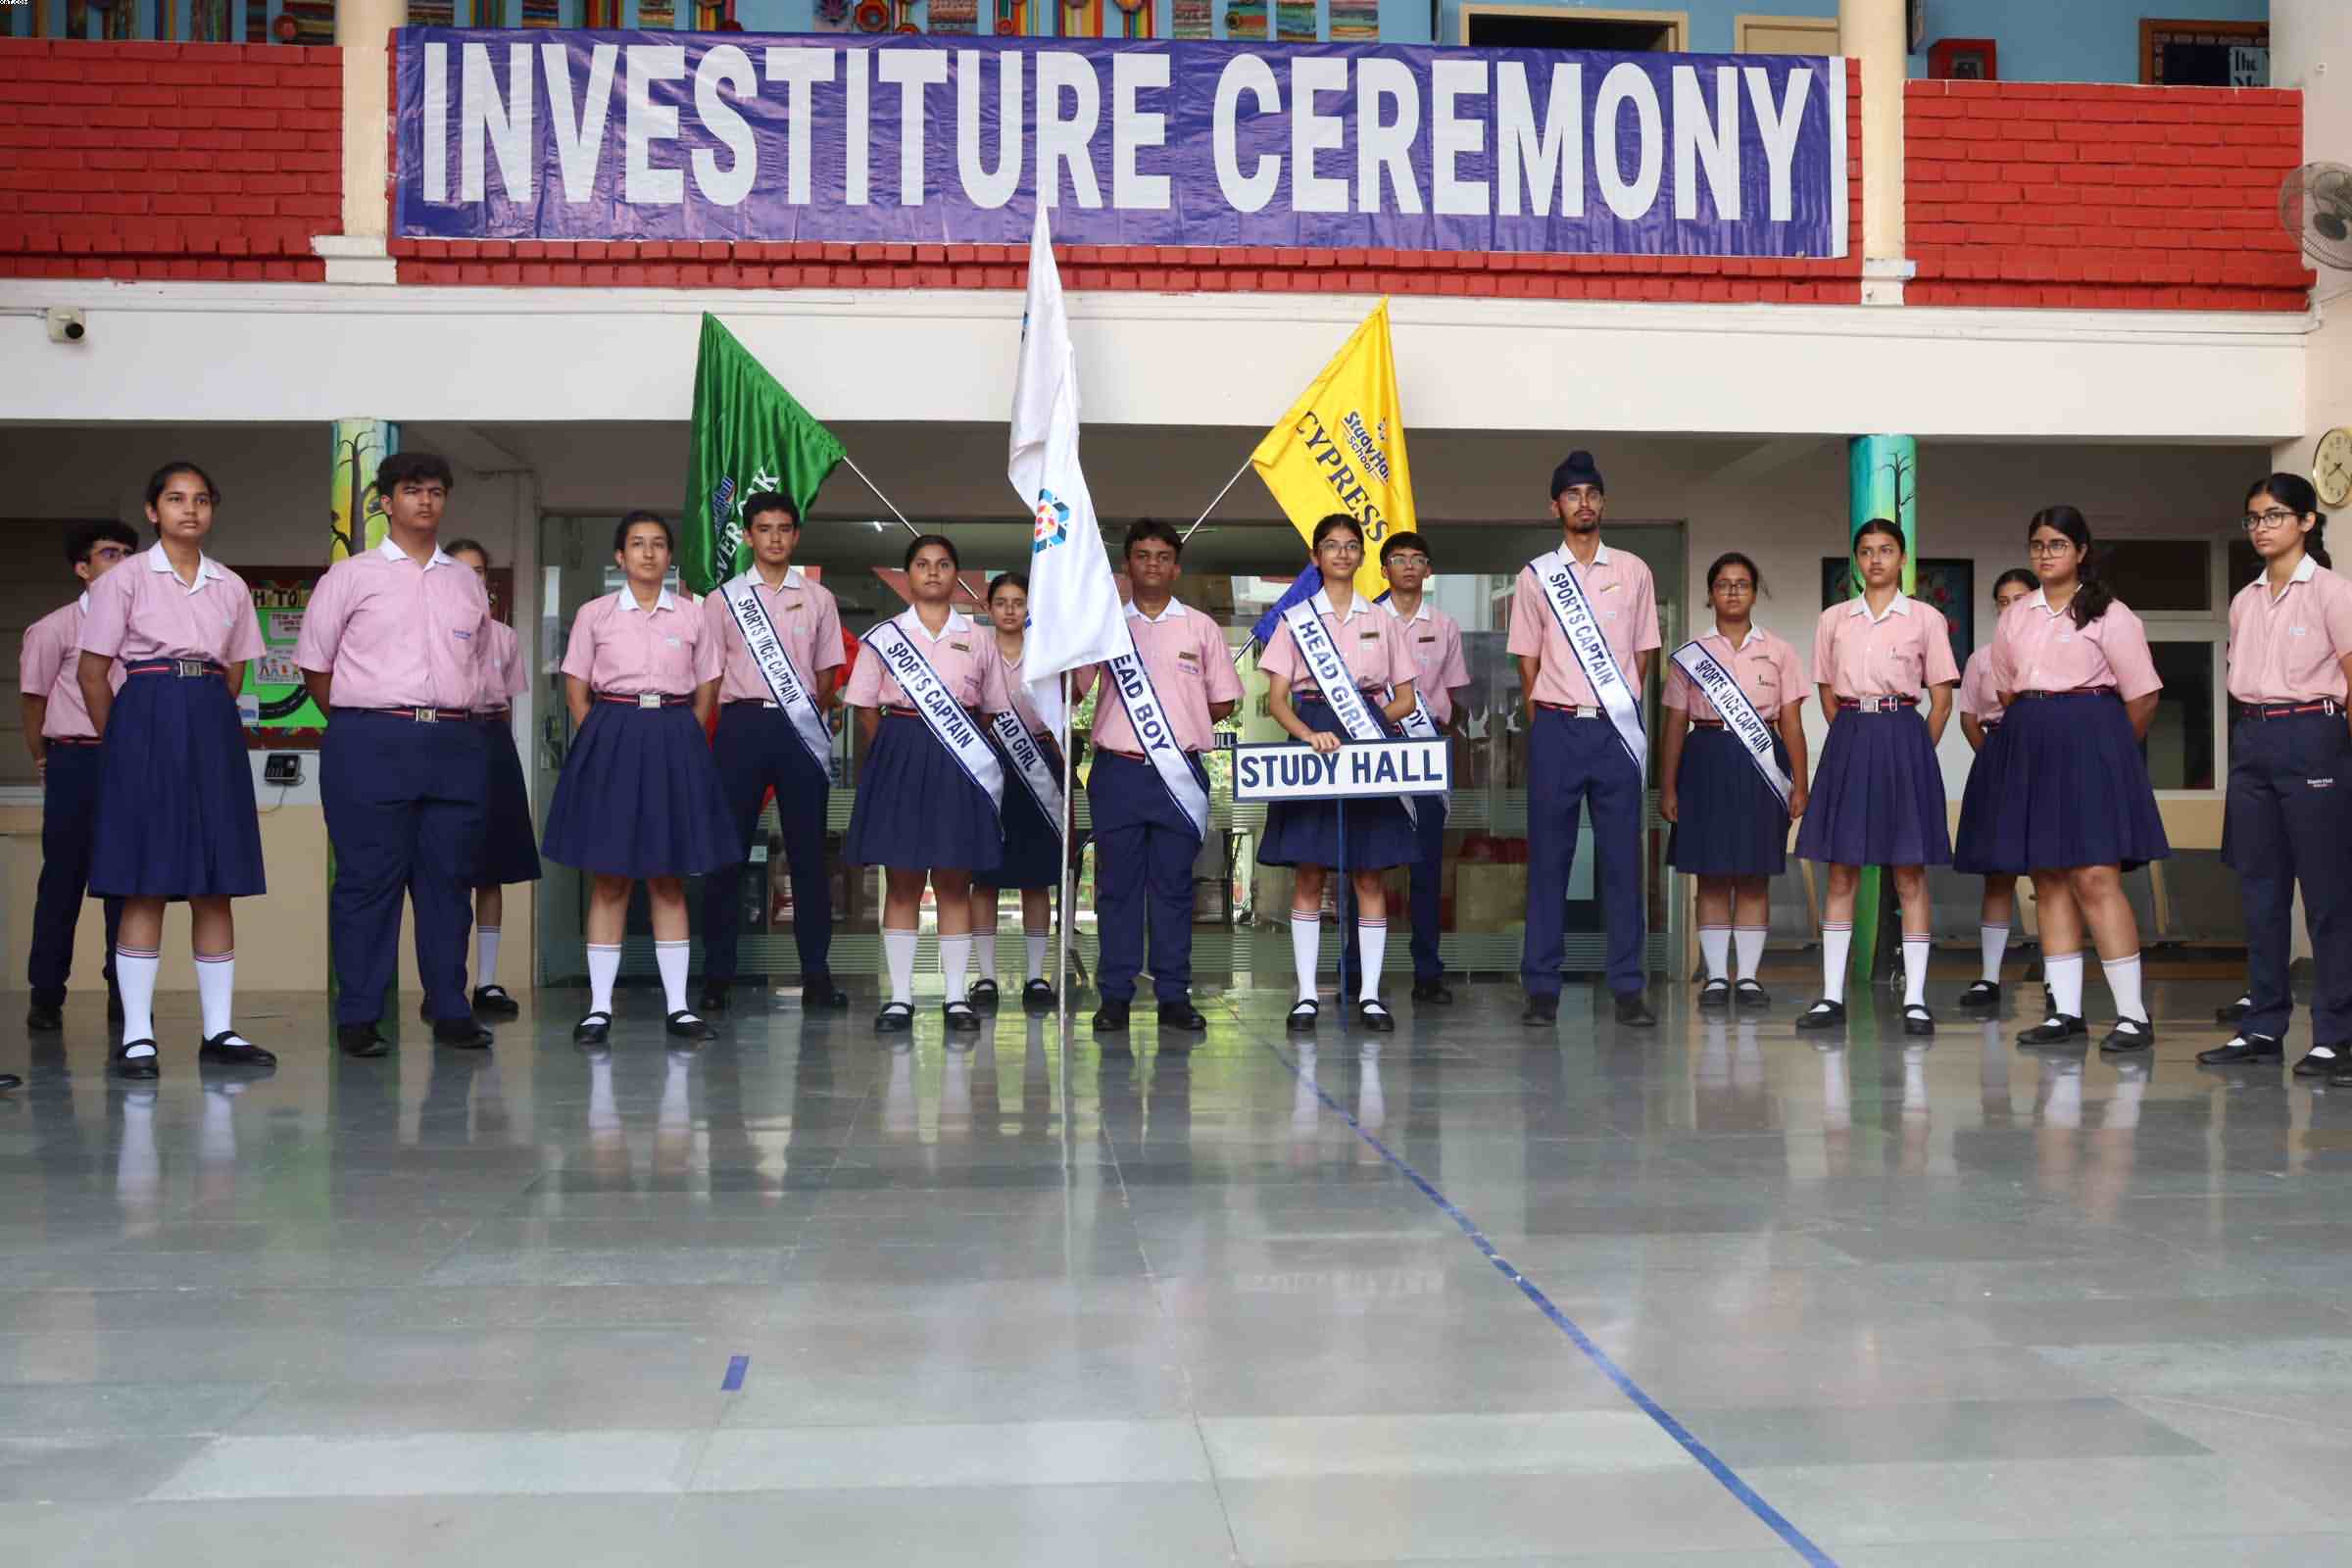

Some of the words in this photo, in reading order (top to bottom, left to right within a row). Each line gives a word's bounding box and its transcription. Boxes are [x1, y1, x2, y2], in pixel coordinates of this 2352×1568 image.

[423, 42, 1172, 209] INVESTITURE
[1212, 53, 1812, 222] CEREMONY
[1296, 411, 1390, 541] CYPRESS
[1344, 411, 1376, 454] Study
[1369, 451, 1389, 483] Hal
[738, 598, 767, 637] SPORTS
[758, 633, 777, 663] VICE
[768, 661, 801, 705] CAPTAIN
[1298, 620, 1339, 680] HEAD
[1330, 687, 1368, 738] GIRL
[1549, 572, 1586, 625] SPORTS
[1575, 624, 1615, 687] CAPTAIN
[887, 642, 932, 691] SPORTS
[923, 689, 975, 749] CAPTAIN
[995, 710, 1020, 738] EAD
[1012, 739, 1038, 772] GIRL
[1113, 654, 1144, 699] EAD
[1134, 703, 1170, 751] BOY
[1694, 659, 1728, 692] SPORTS
[1719, 689, 1742, 716] VICE
[1736, 710, 1772, 754] CAPTAIN
[1241, 752, 1340, 788] STUDY
[1351, 749, 1443, 785] HALL
